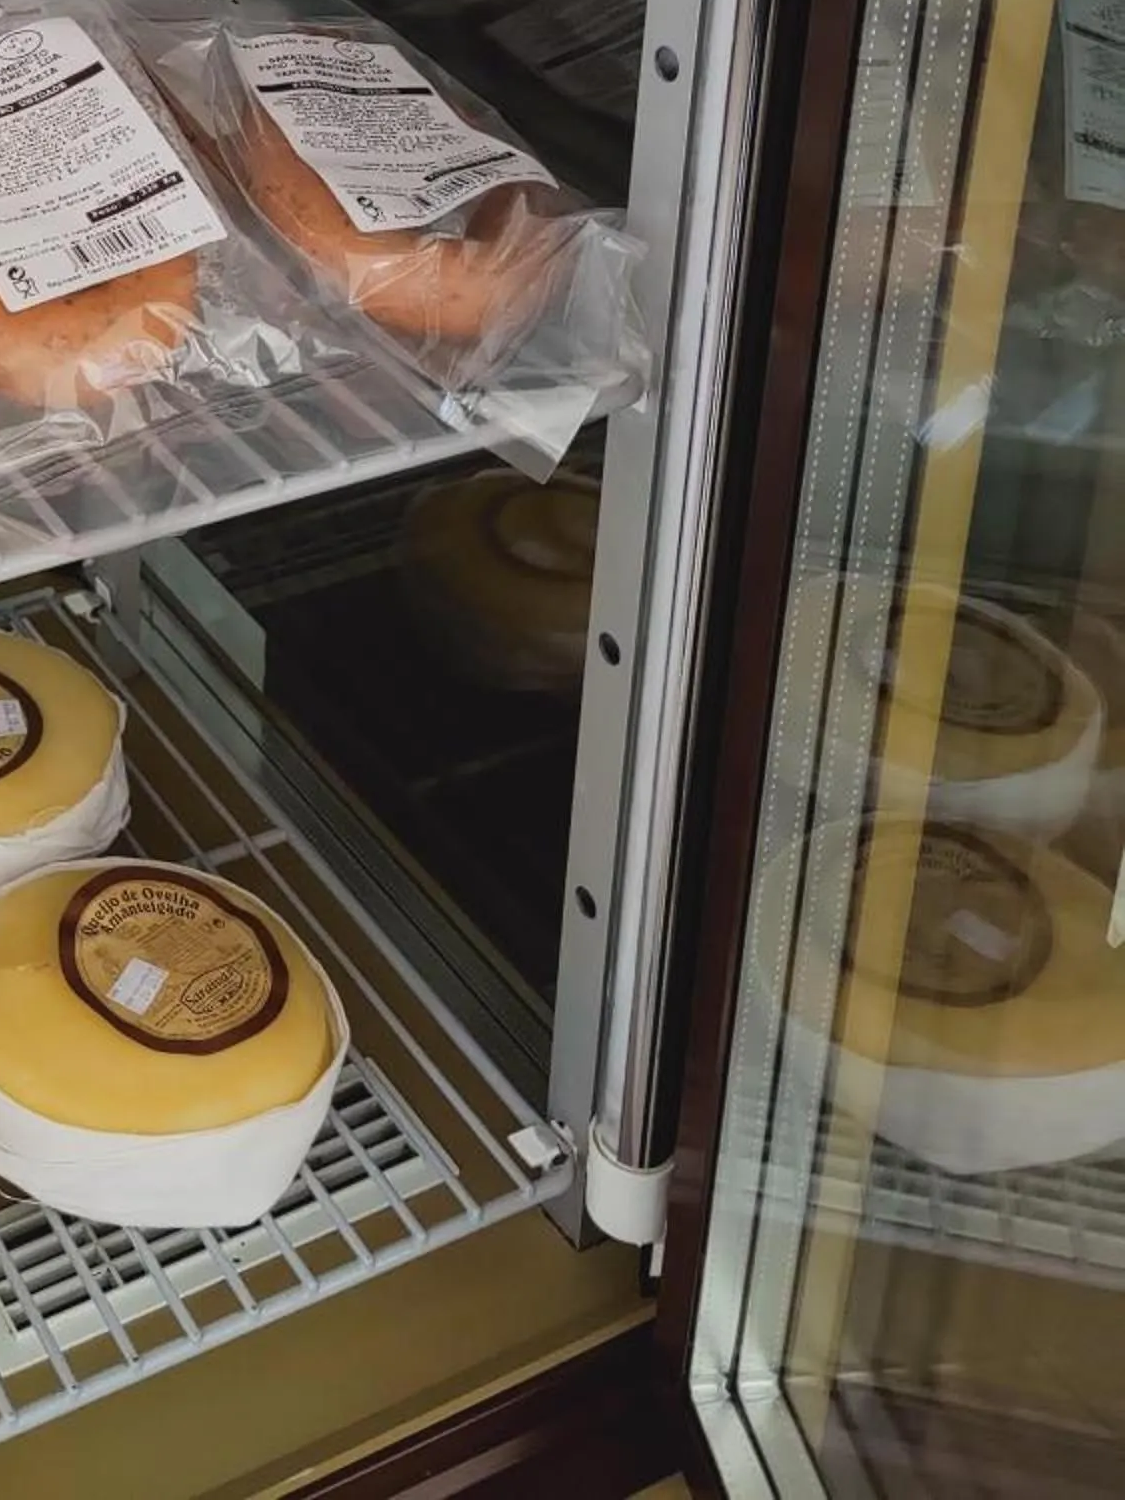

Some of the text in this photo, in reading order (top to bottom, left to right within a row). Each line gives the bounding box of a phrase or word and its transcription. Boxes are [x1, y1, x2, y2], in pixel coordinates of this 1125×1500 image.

[120, 889, 138, 903] de
[141, 886, 201, 911] Ovelha
[102, 900, 197, 934] Amanteigado
